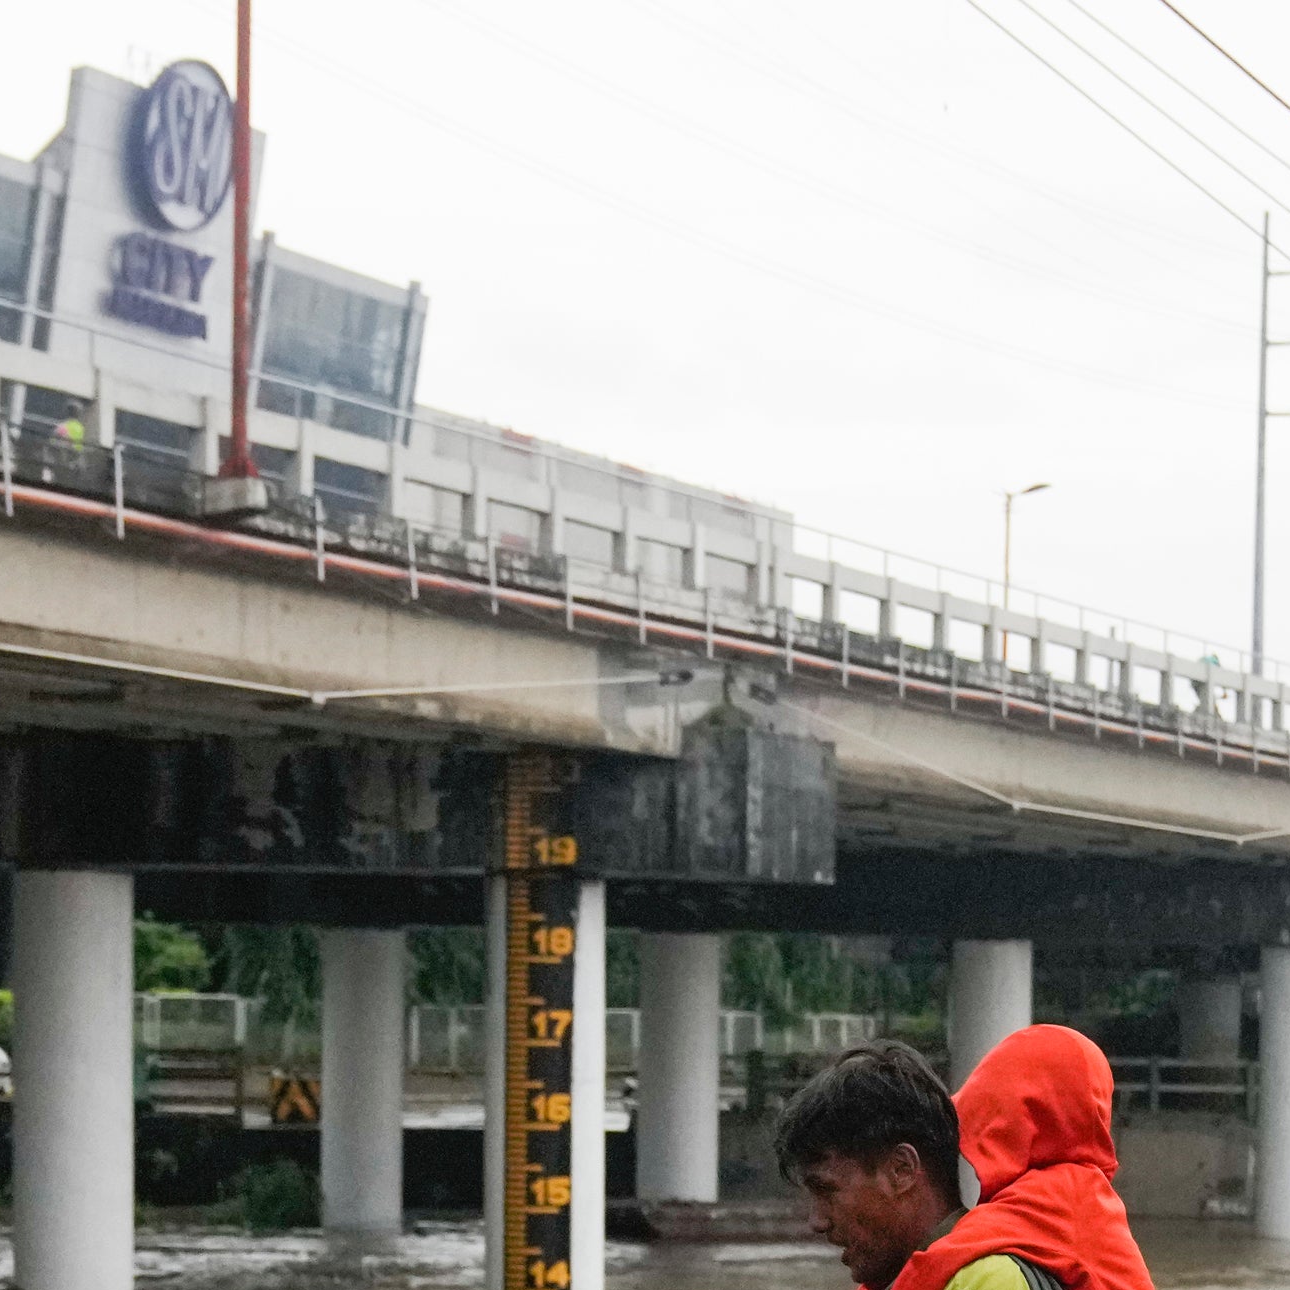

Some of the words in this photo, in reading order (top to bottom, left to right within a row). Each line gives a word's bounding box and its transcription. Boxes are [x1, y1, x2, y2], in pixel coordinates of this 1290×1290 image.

[109, 232, 214, 302] CITY
[535, 836, 578, 866] 19
[533, 926, 575, 957] 18
[532, 1009, 573, 1040] 17
[531, 1092, 572, 1123] 16
[530, 1175, 571, 1206] 15
[529, 1260, 571, 1289] 14
